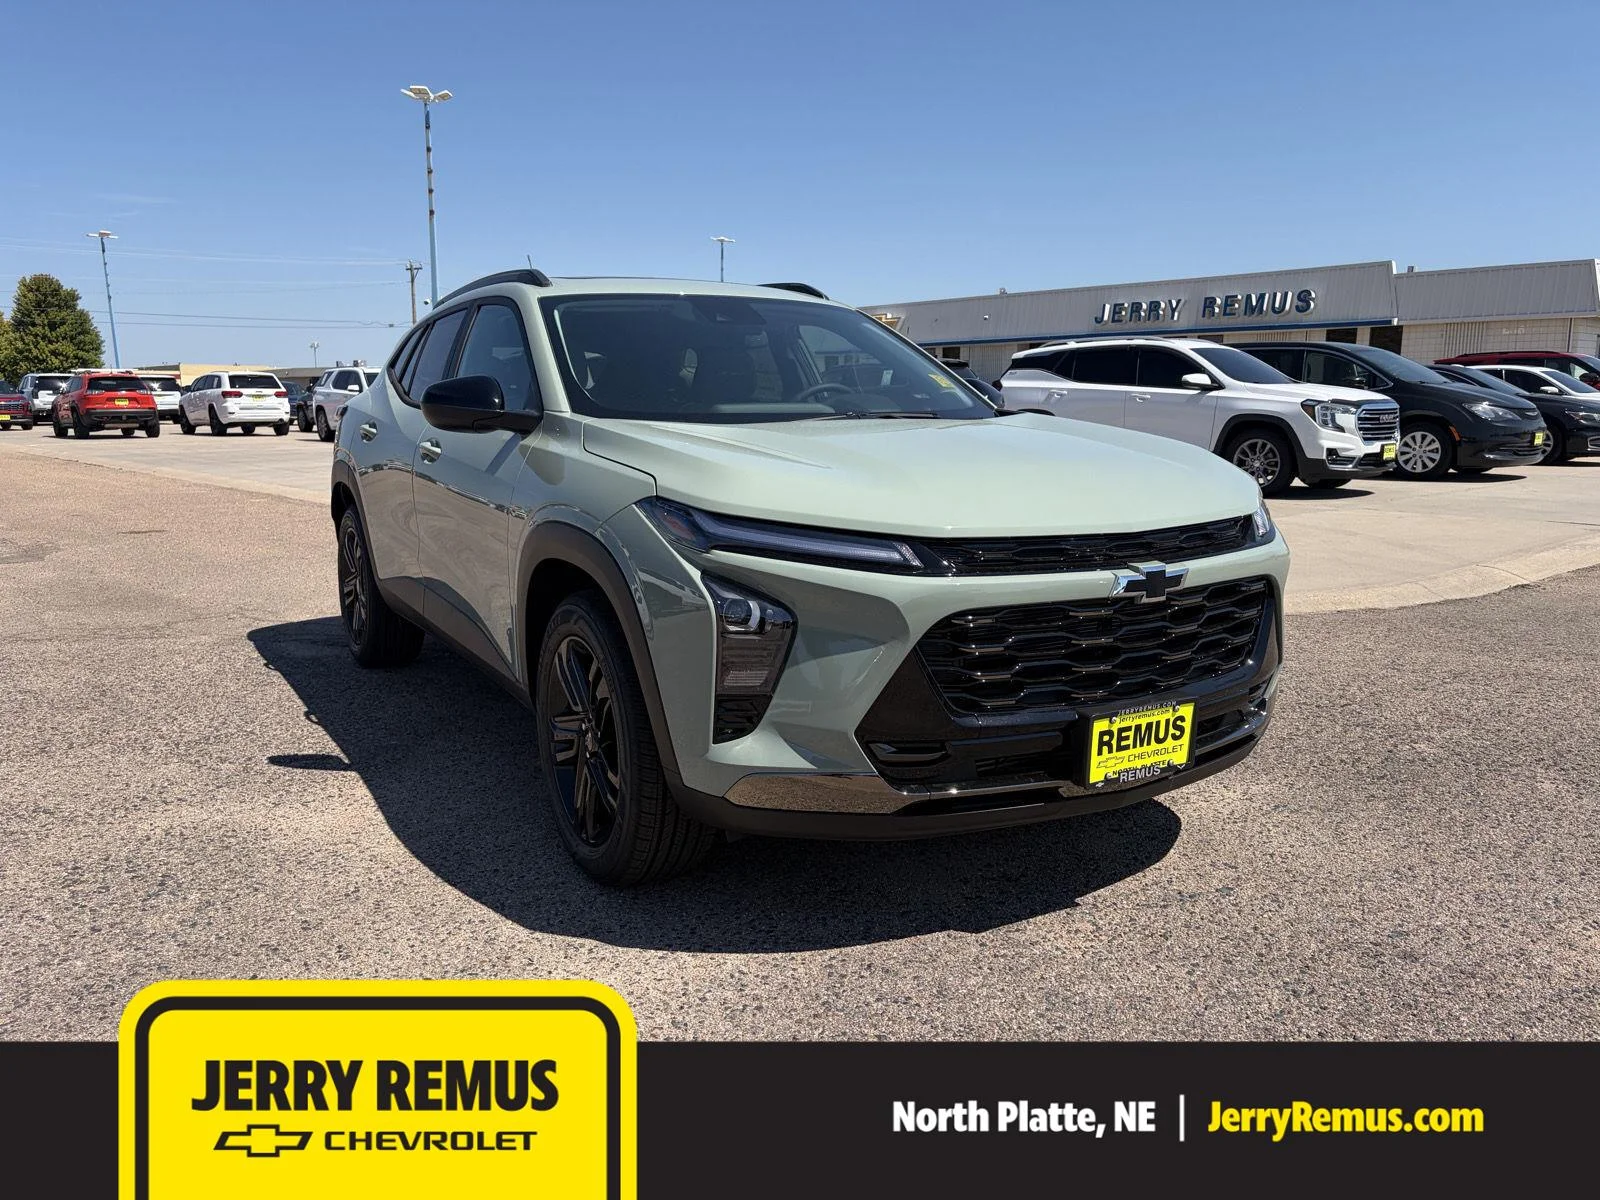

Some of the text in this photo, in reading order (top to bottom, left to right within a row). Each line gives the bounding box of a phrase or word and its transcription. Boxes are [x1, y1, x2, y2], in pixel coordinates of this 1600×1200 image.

[1094, 289, 1316, 325] JERRY REMUS
[1117, 701, 1177, 716] JERRYREMUS.COM
[1097, 715, 1186, 757] REMUS
[1127, 744, 1185, 763] CHEVROLET
[1119, 765, 1161, 783] REMUS
